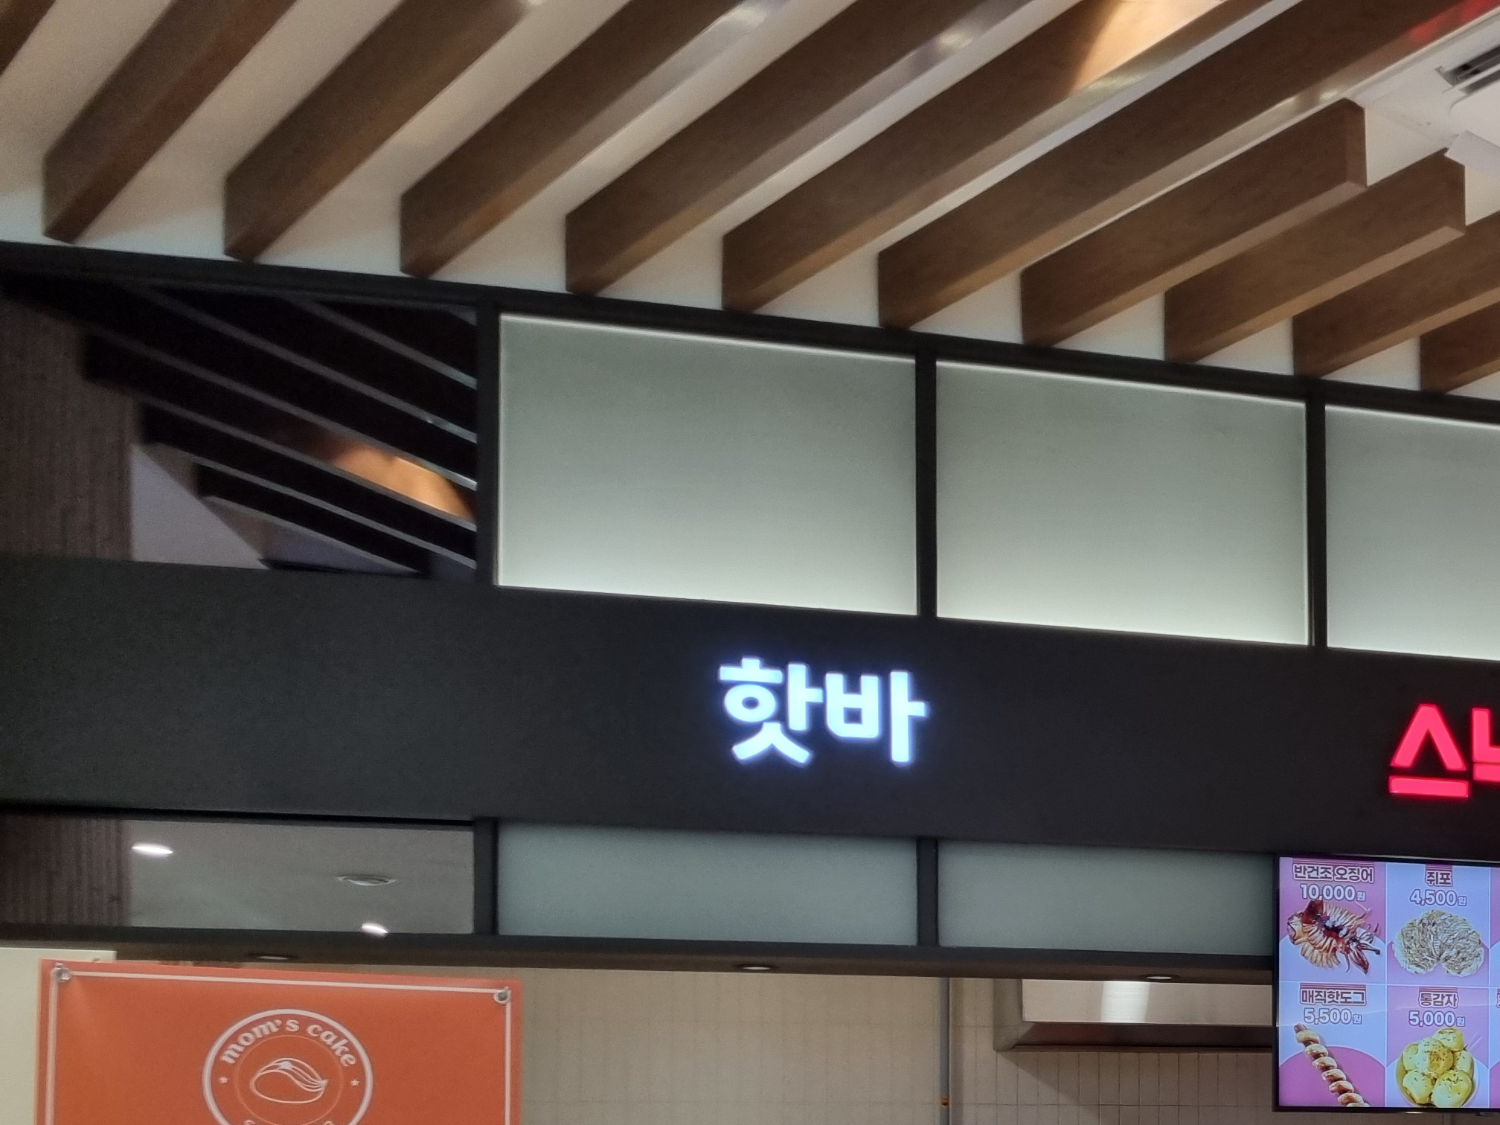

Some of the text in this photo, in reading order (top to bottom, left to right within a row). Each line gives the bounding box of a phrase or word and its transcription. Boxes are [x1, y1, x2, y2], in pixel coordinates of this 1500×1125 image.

[718, 656, 930, 766] 핫바
[1293, 865, 1374, 883] 반건조 오징어
[1426, 870, 1452, 887] 쥐포
[1300, 885, 1366, 902] 10,000원
[1300, 988, 1366, 1006] 매직핫도그
[1418, 991, 1458, 1008] 통감자
[221, 1017, 358, 1068] mom's cake
